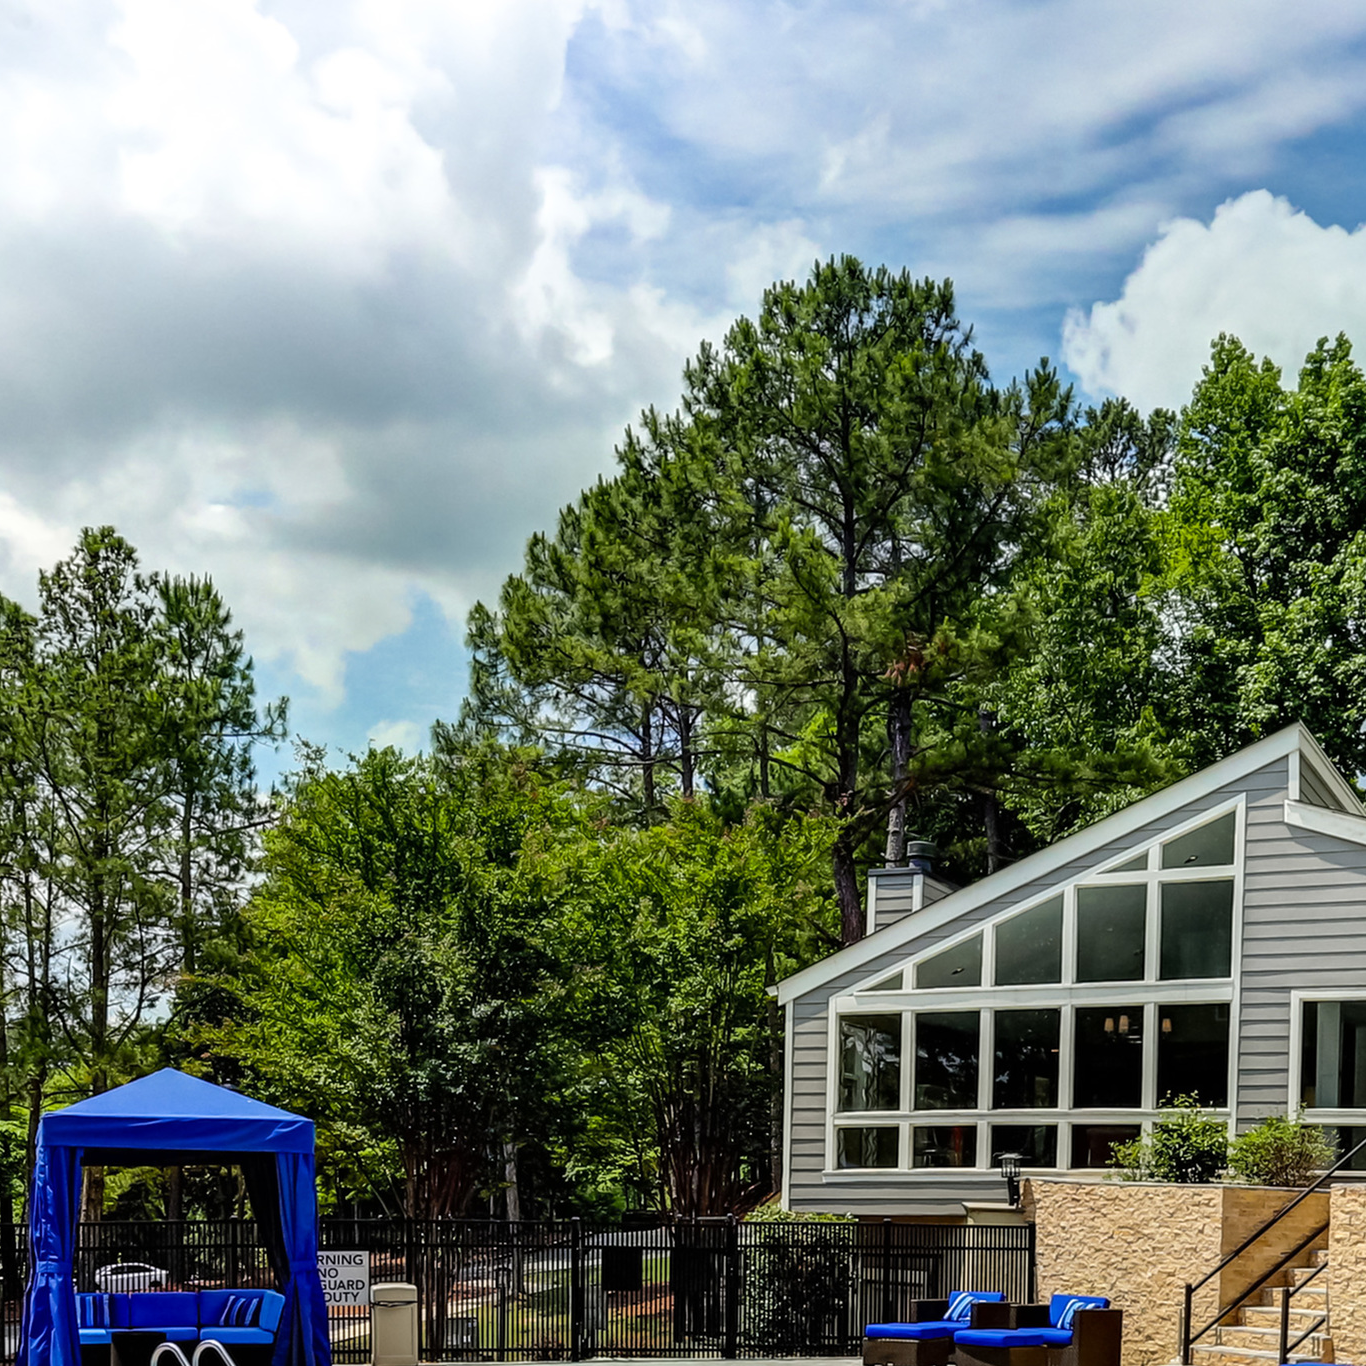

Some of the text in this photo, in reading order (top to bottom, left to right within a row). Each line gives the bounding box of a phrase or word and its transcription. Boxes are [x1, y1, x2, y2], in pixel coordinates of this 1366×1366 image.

[317, 1254, 363, 1265] RNING
[318, 1268, 338, 1278] NO
[321, 1280, 365, 1290] GUARD
[324, 1292, 359, 1302] DUTY
